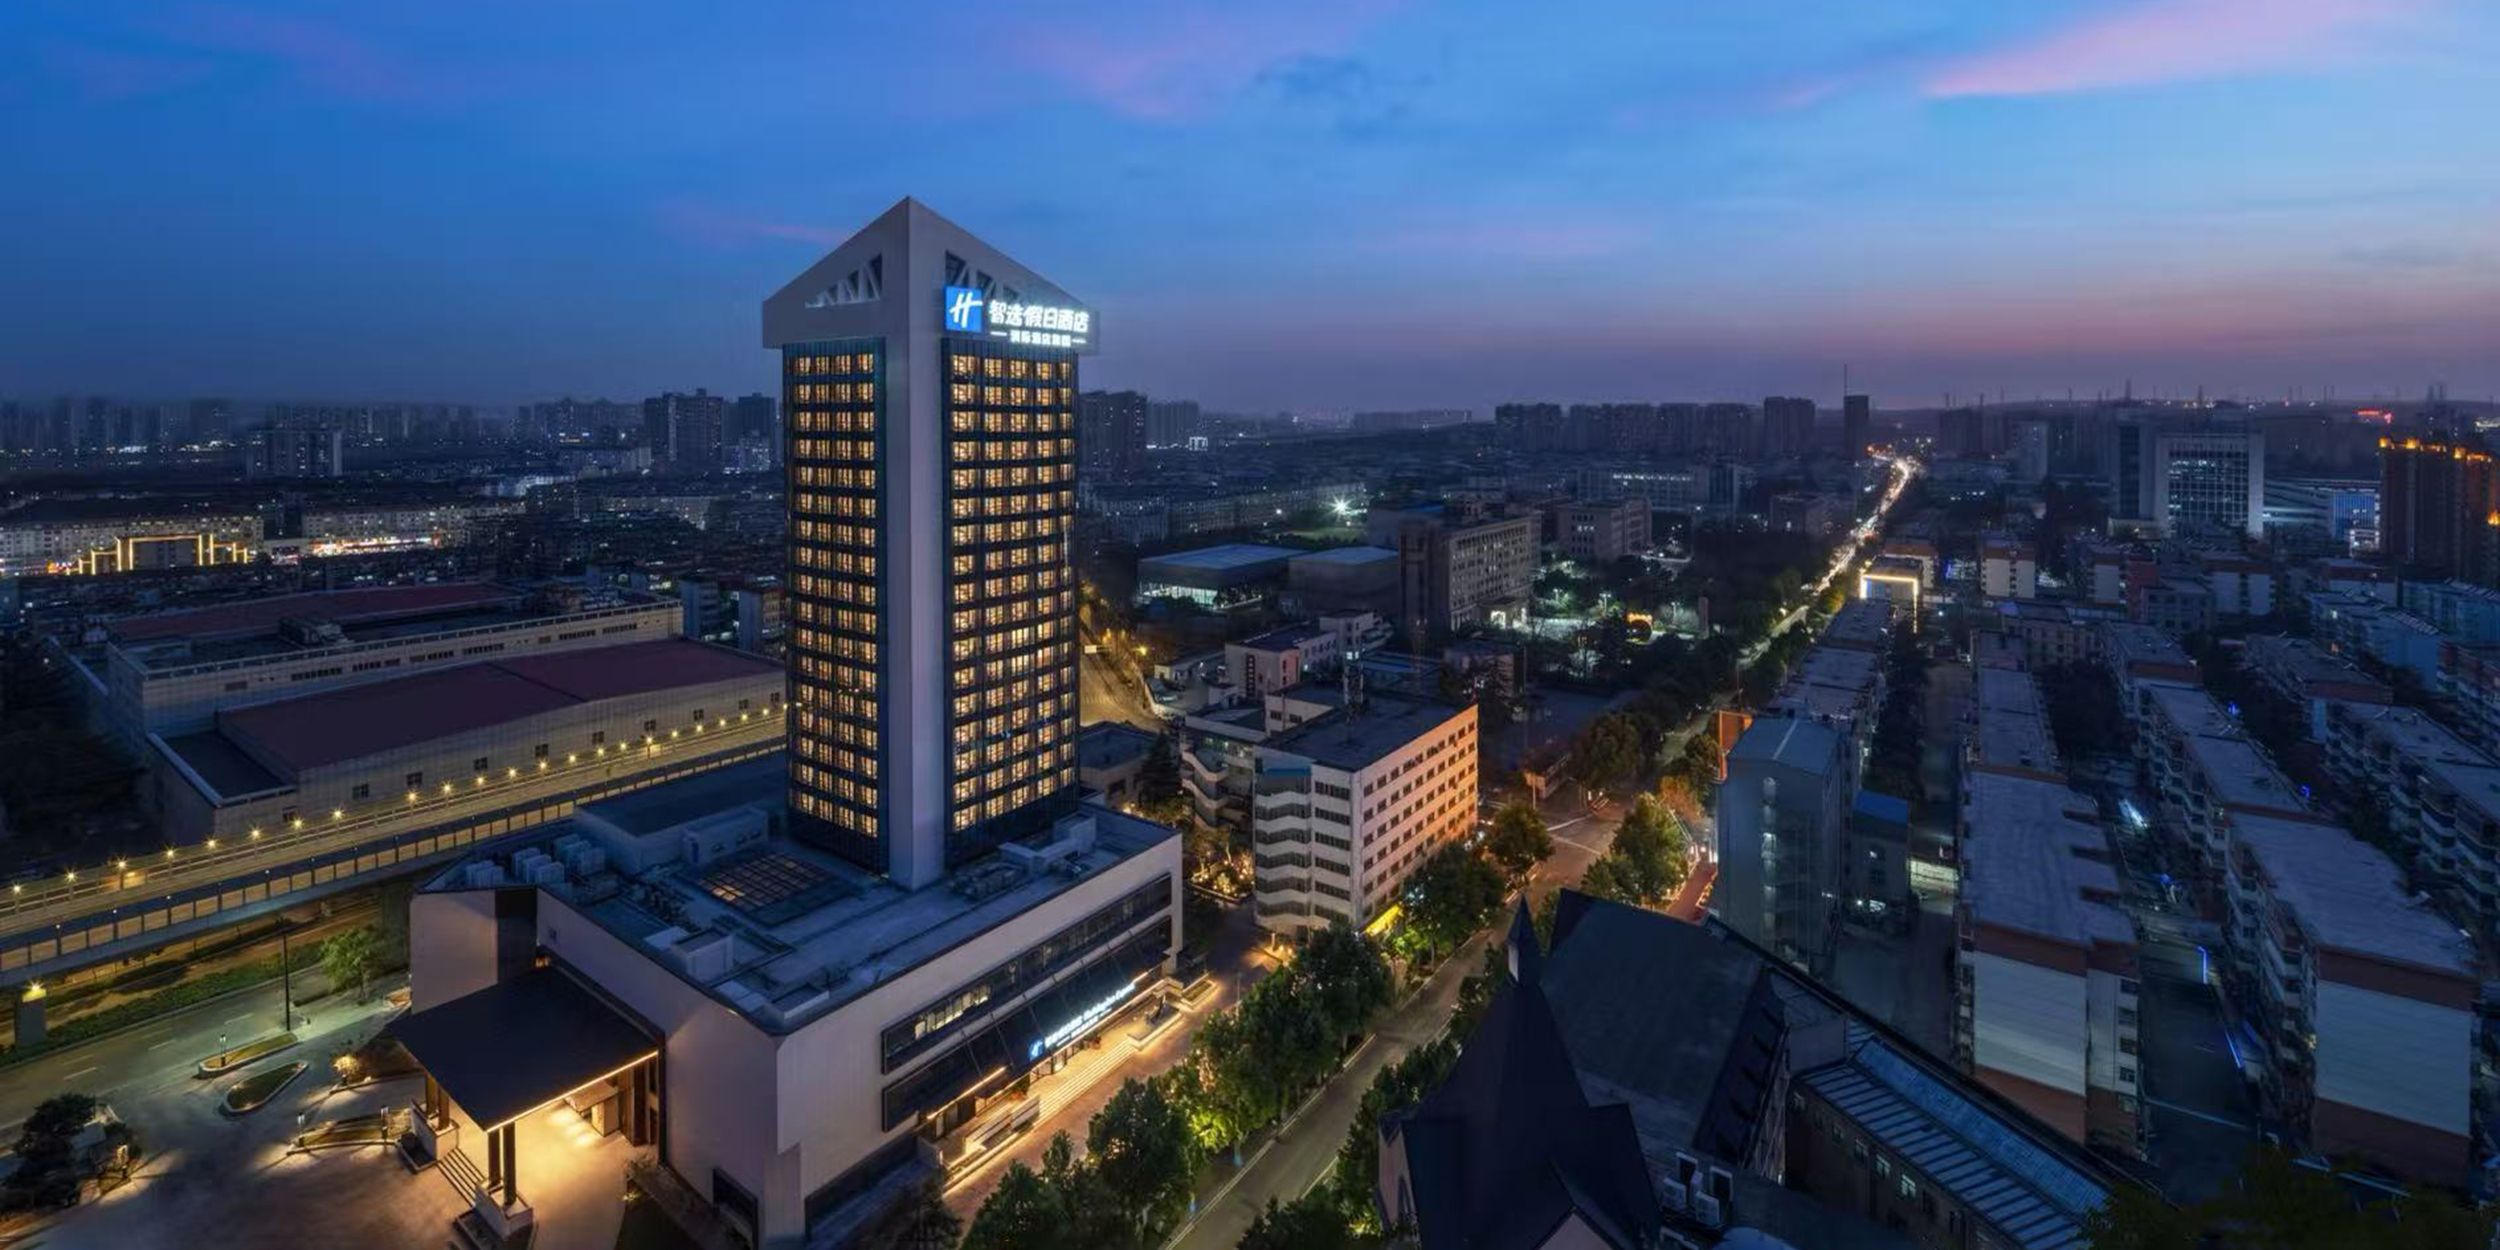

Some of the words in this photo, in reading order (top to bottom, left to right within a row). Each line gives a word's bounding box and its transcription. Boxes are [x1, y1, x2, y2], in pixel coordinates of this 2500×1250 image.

[989, 299, 1089, 333] 智选假日酒店
